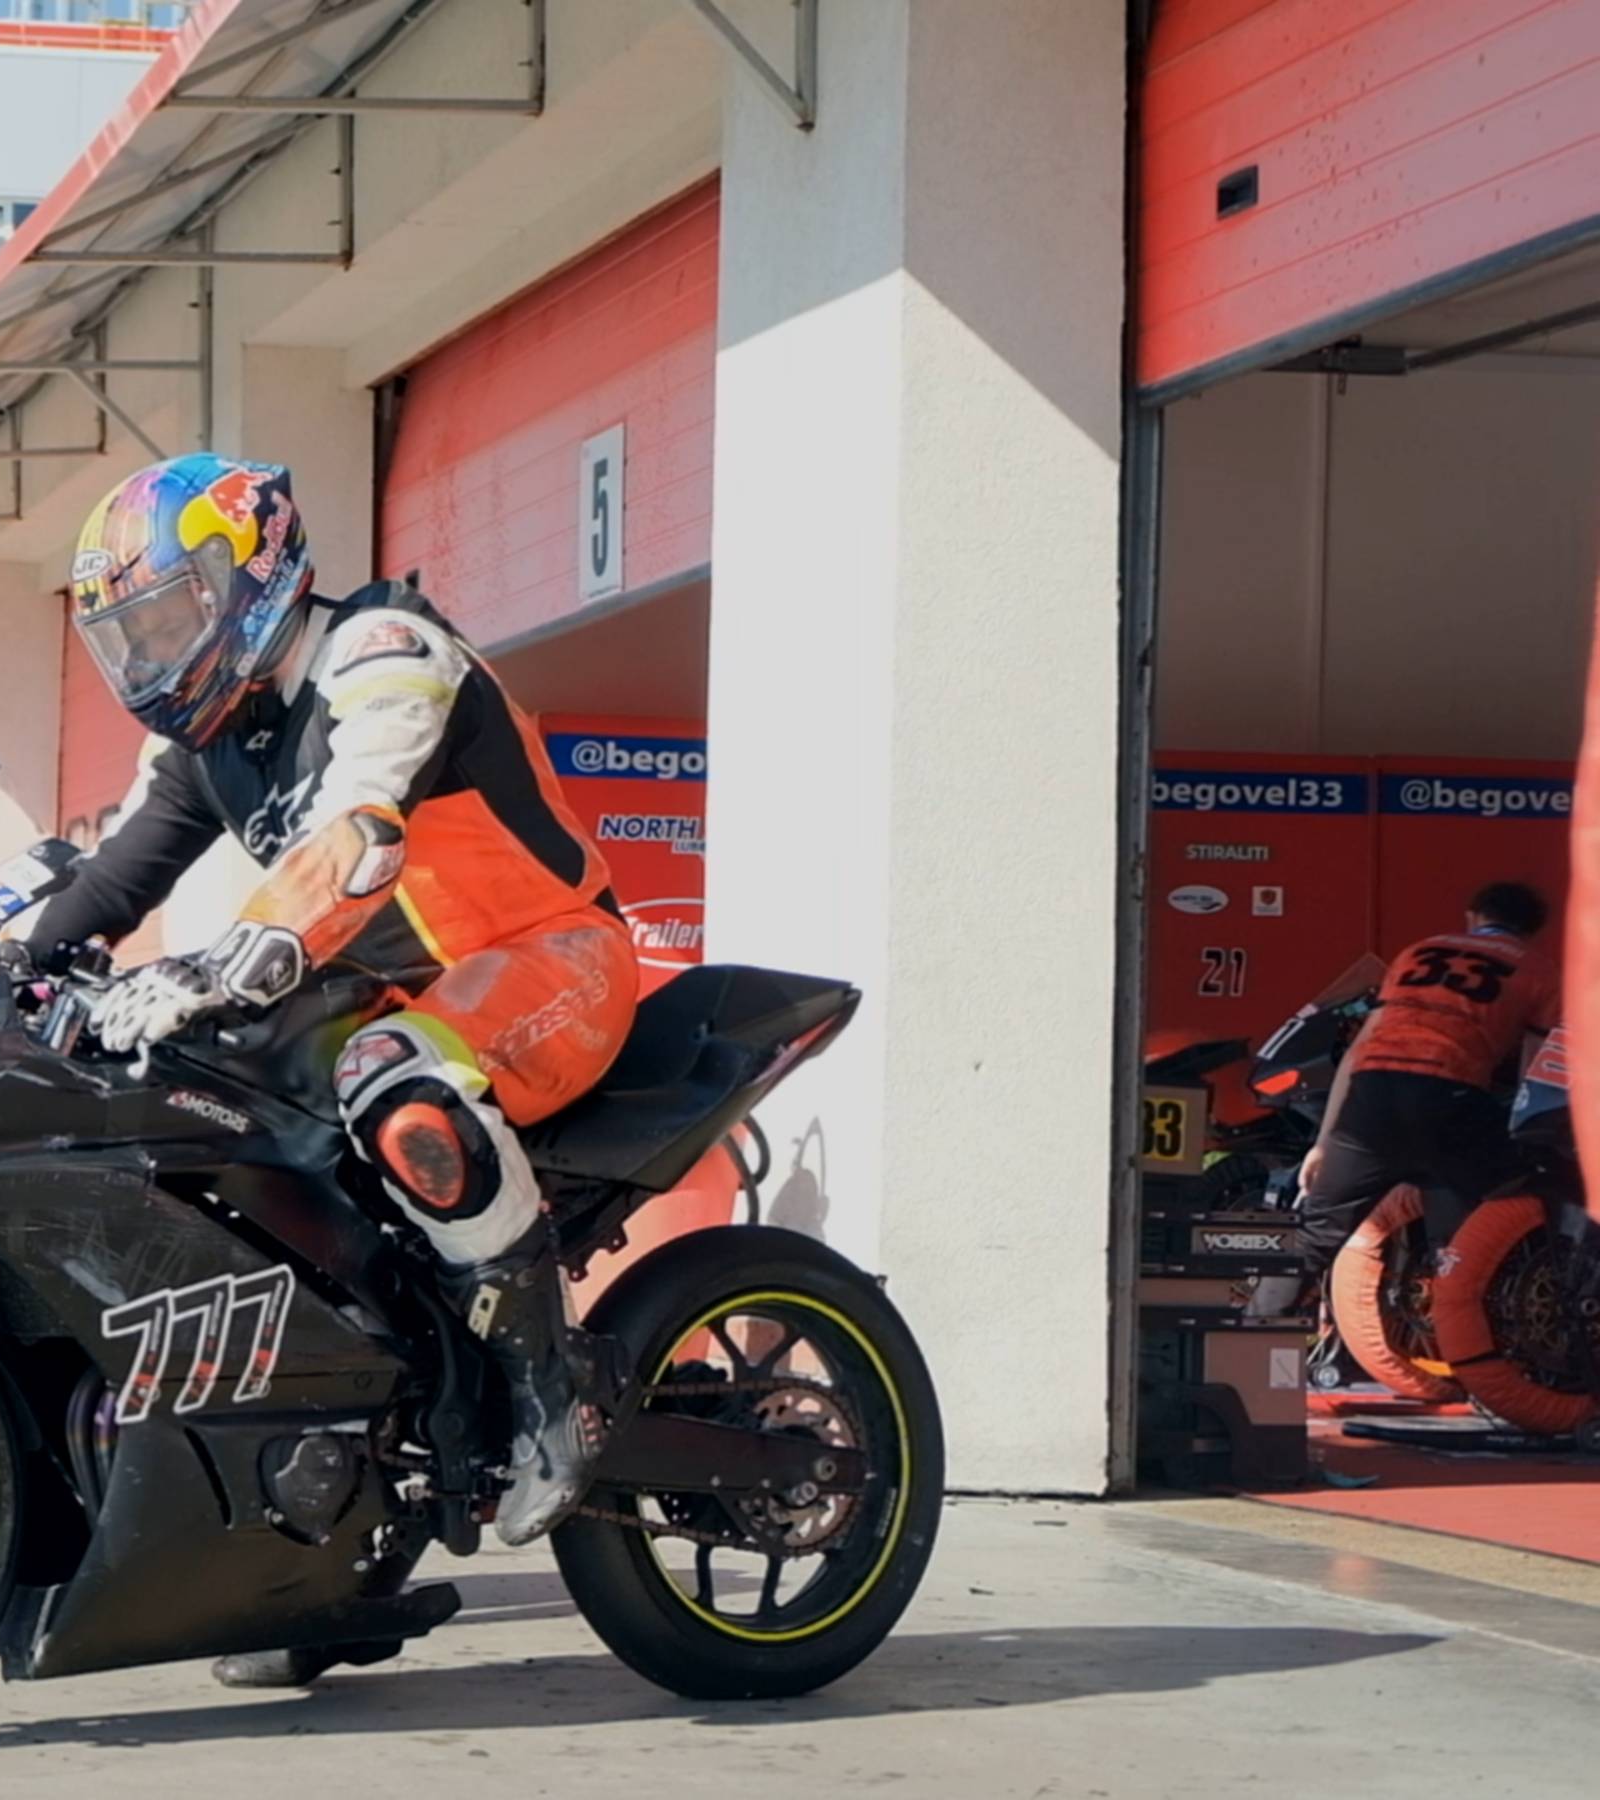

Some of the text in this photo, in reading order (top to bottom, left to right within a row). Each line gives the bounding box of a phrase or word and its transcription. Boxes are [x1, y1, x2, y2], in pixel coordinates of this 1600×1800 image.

[591, 458, 609, 577] 5
[598, 815, 699, 841] NORTH
[1185, 843, 1270, 861] STIRALITI
[1199, 947, 1247, 997] 21
[1397, 946, 1516, 1004] 33
[101, 1263, 295, 1424] 777
